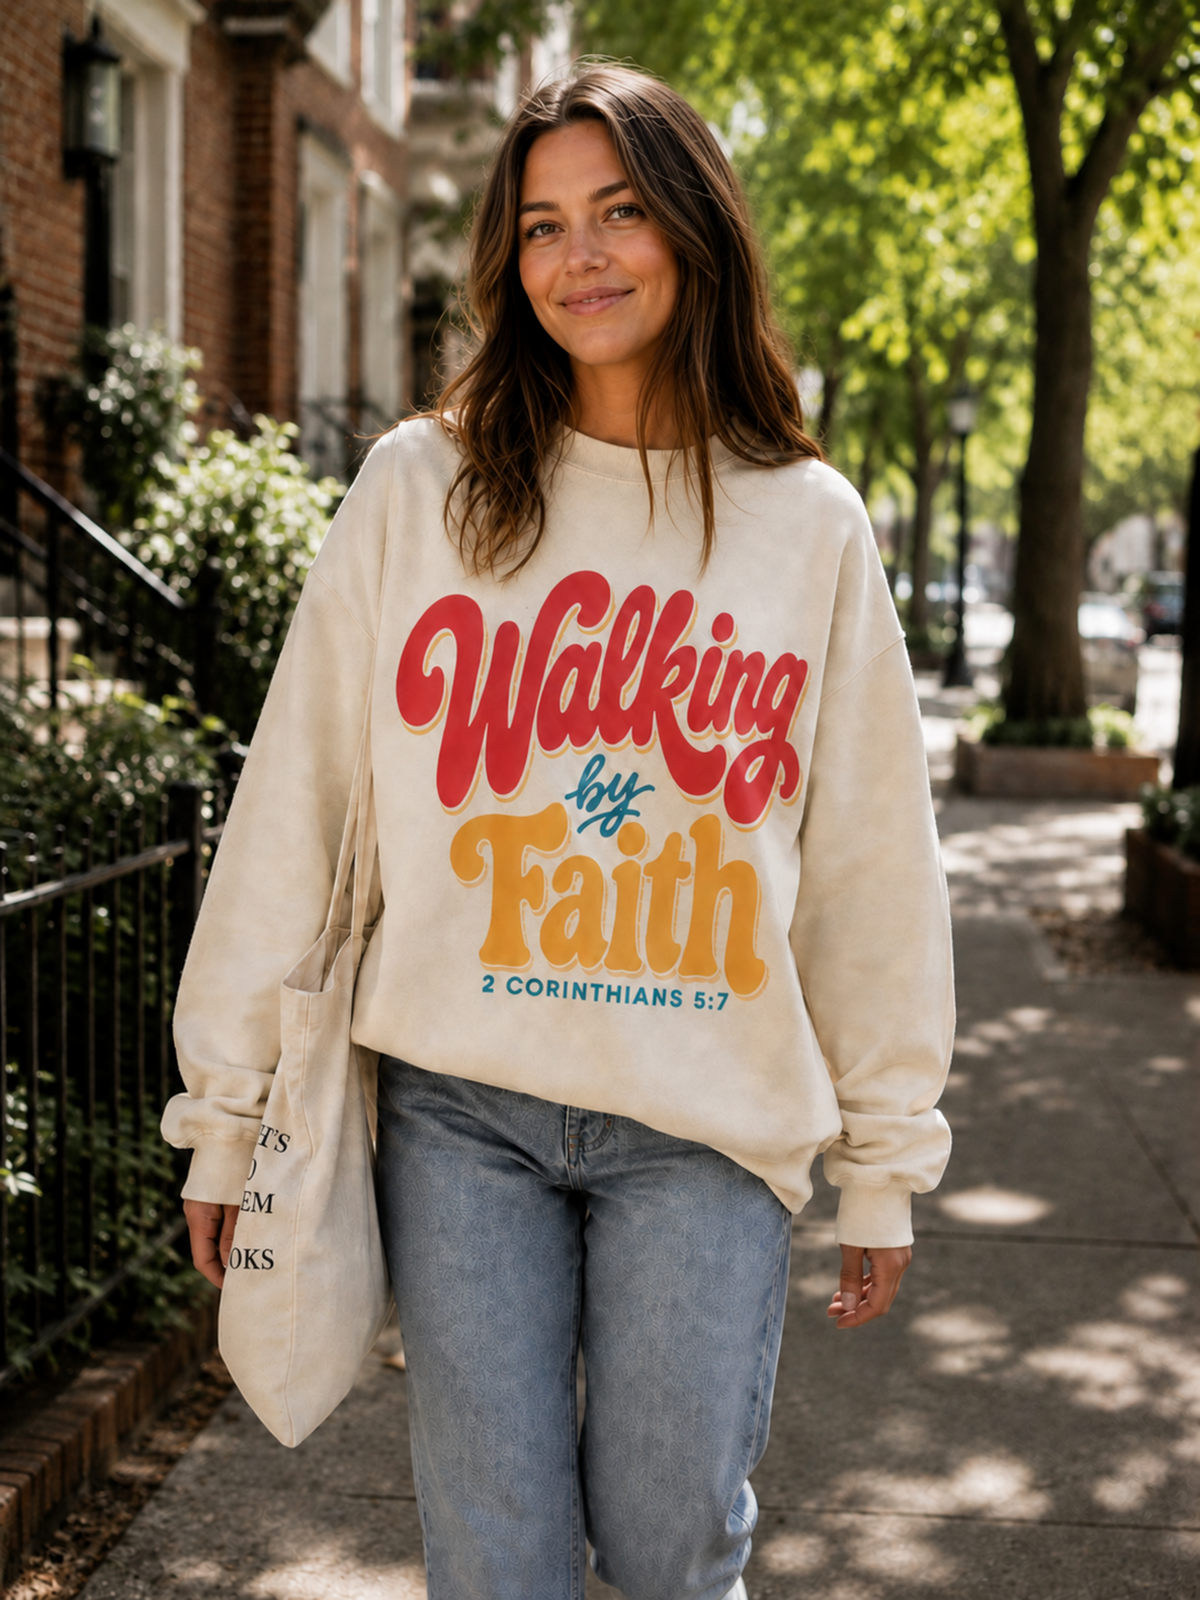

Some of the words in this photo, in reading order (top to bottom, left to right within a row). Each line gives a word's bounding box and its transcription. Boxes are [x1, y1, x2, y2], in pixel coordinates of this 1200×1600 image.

[396, 570, 809, 832] Walking
[564, 753, 655, 837] by
[450, 802, 769, 1001] Faith
[481, 974, 495, 993] 2
[506, 976, 683, 1008] CORINTHIANS
[693, 992, 729, 1011] 5:7
[229, 1247, 275, 1270] OKS
